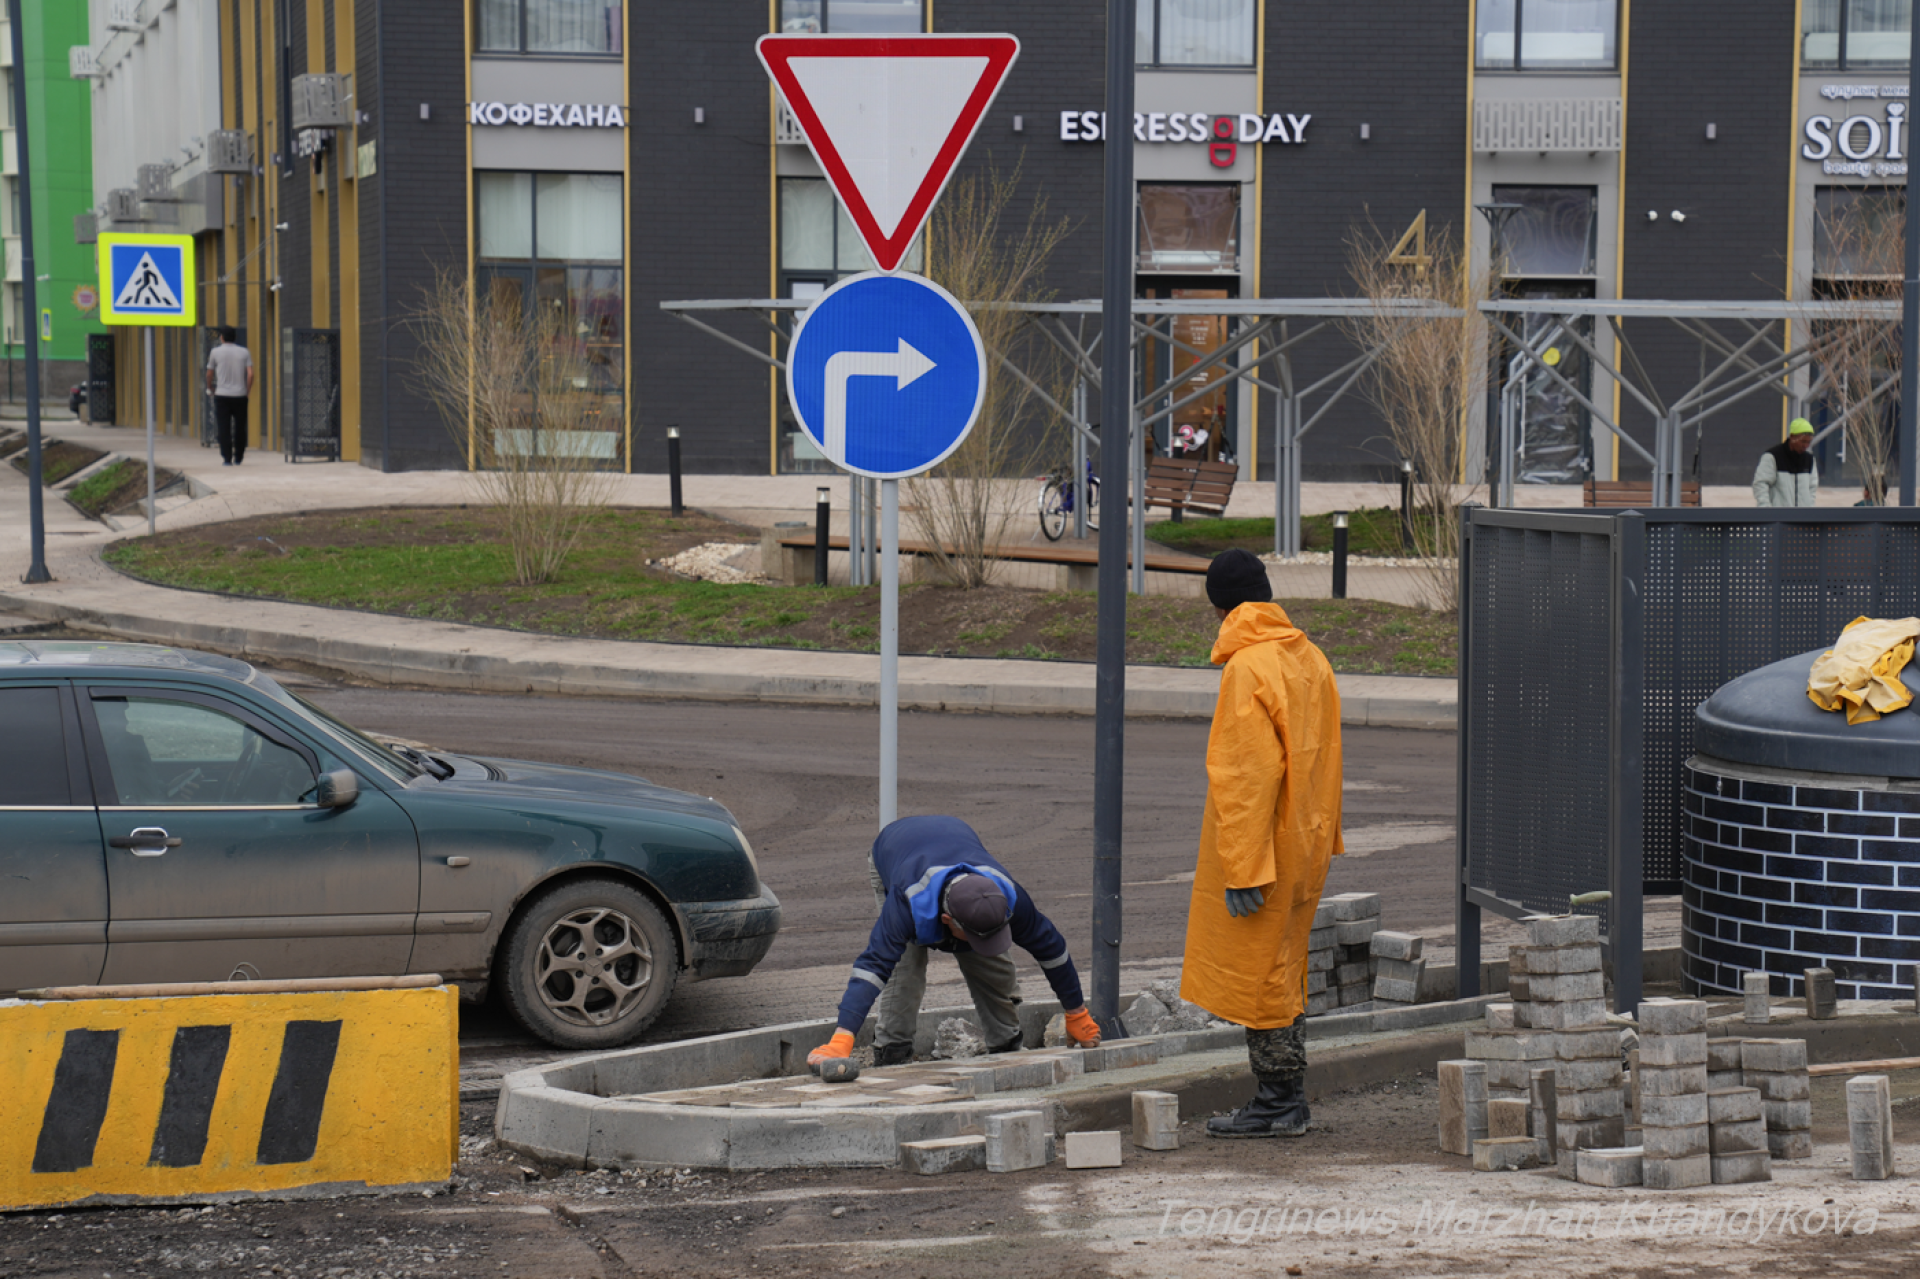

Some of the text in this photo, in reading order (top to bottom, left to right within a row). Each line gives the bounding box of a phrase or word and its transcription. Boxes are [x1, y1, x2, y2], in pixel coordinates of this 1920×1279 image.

[470, 102, 625, 127] КОФЕХАНА
[1823, 157, 1872, 178] beauty
[1385, 208, 1432, 280] 4
